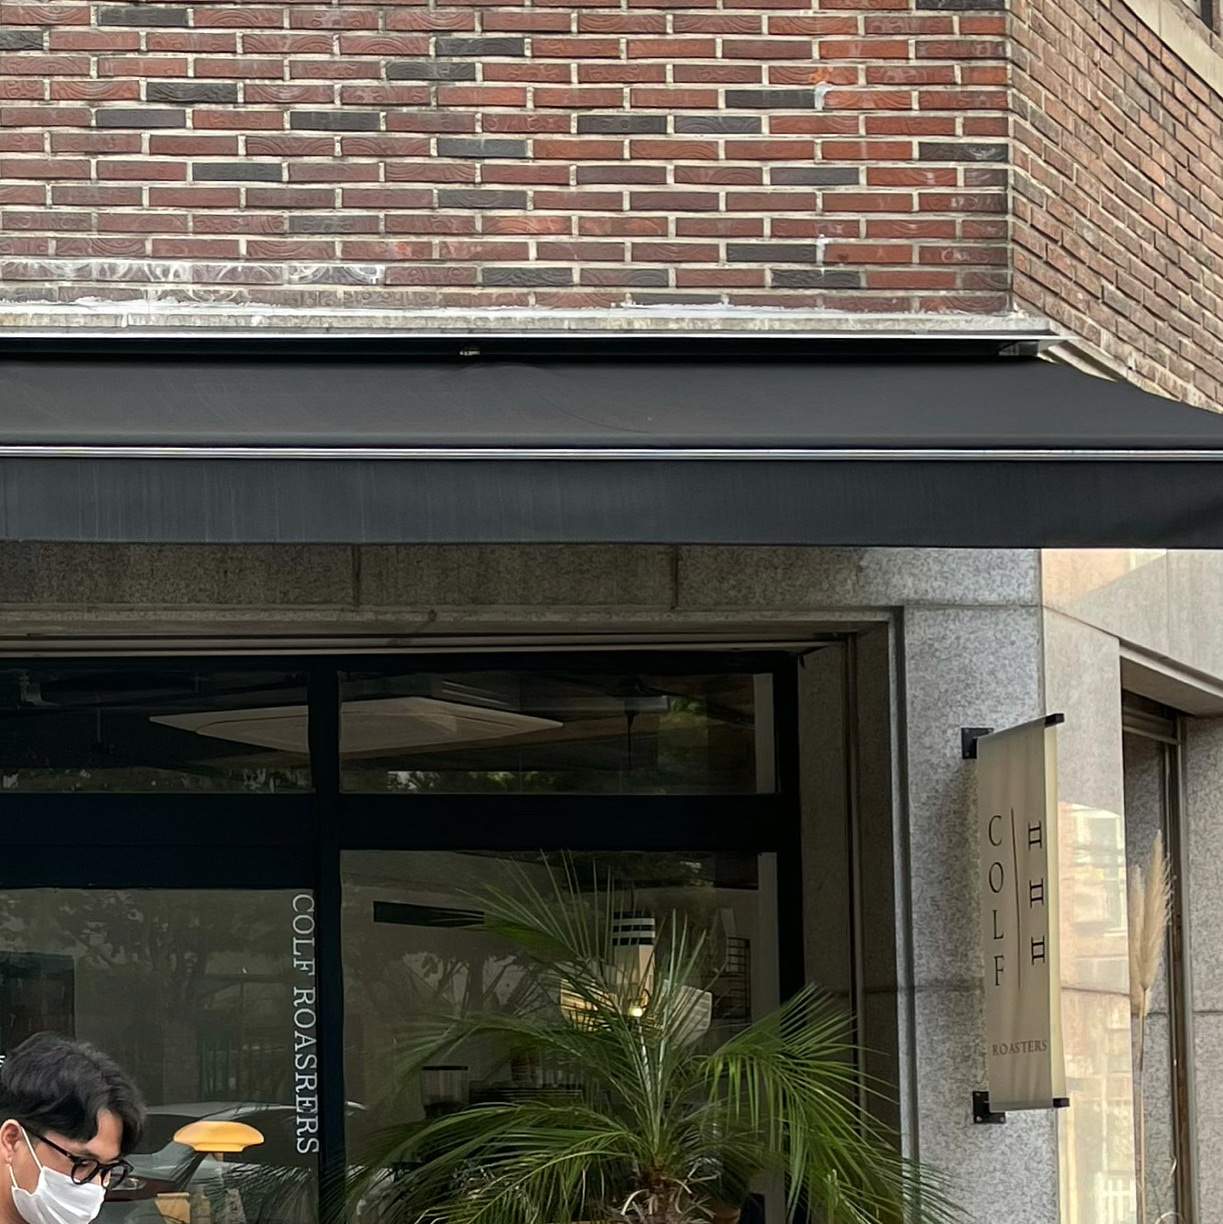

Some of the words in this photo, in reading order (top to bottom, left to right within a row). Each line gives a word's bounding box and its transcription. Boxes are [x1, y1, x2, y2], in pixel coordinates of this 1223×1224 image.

[292, 893, 316, 976] COLF
[988, 815, 1005, 987] COLF
[992, 1040, 1048, 1056] ROASTERS
